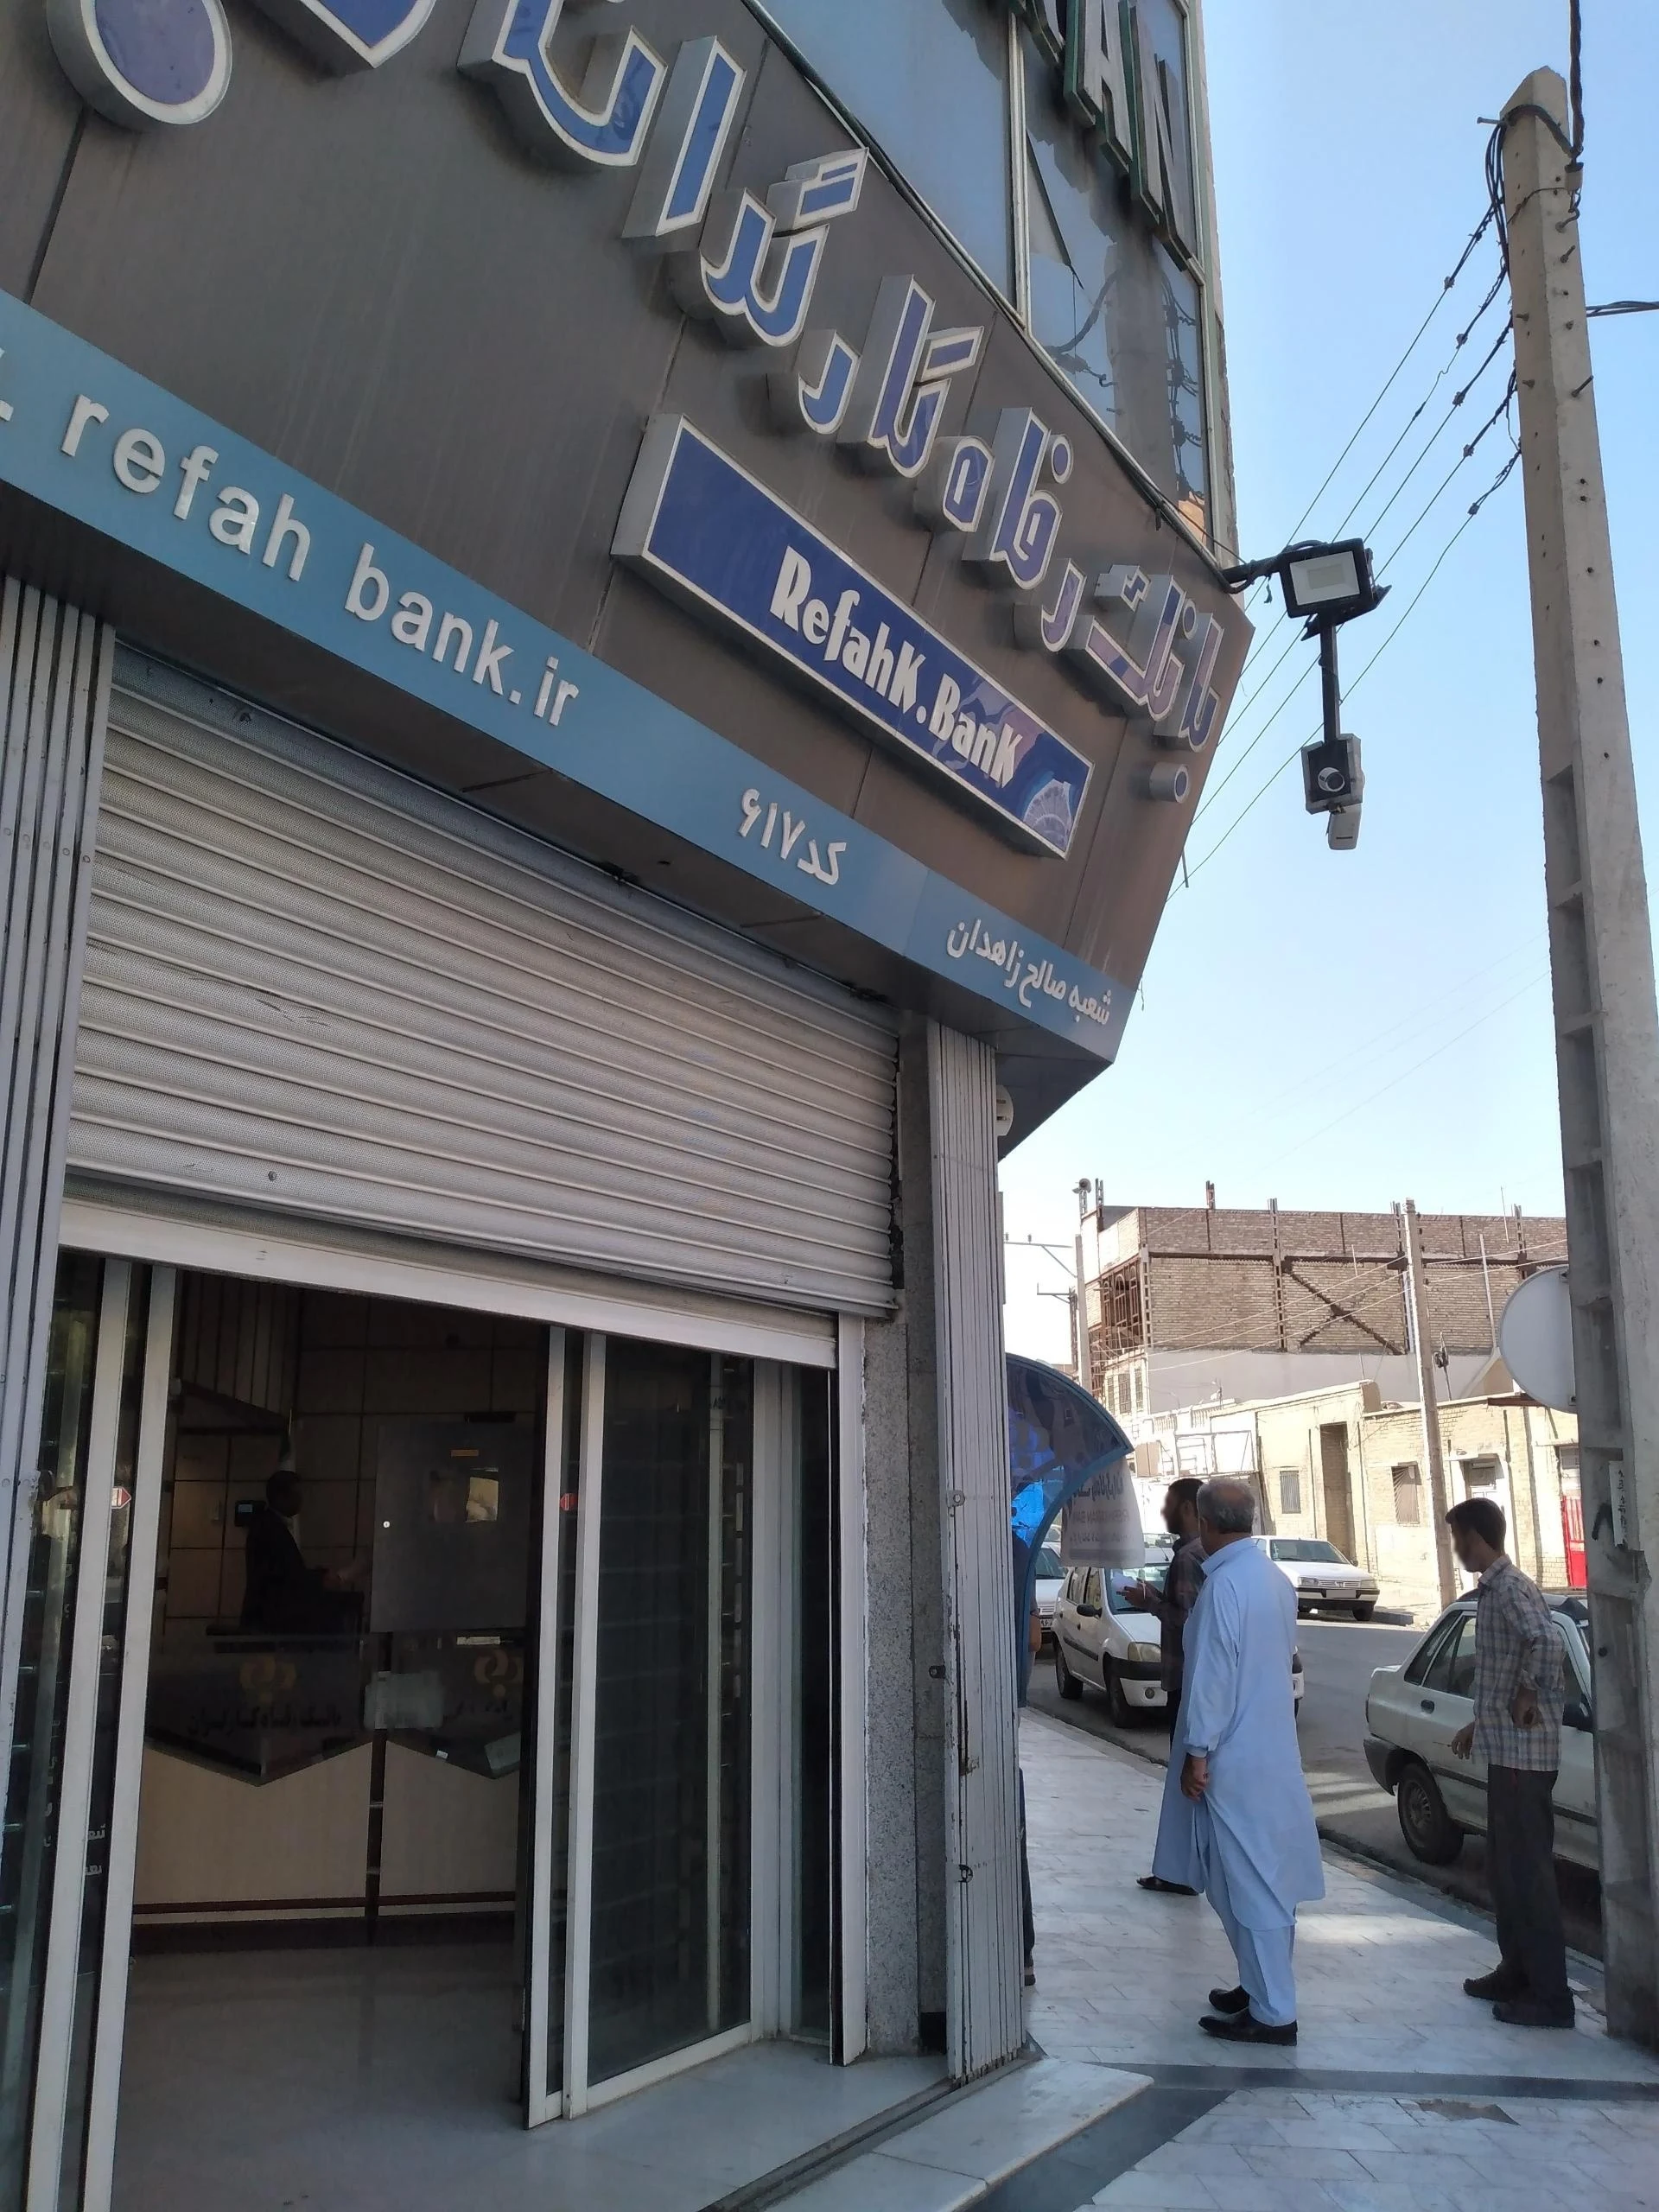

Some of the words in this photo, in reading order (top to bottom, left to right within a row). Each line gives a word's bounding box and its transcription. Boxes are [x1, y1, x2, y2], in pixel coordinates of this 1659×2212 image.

[1011, 0, 1198, 271] AN
[60, 394, 312, 582] refah
[345, 543, 580, 727] bank.ir
[938, 406, 1087, 653] رفاه
[1078, 566, 1224, 804] بانک
[946, 918, 1025, 988] زاهدان
[1018, 960, 1067, 1008] صالح
[1068, 985, 1112, 1026] شعبه
